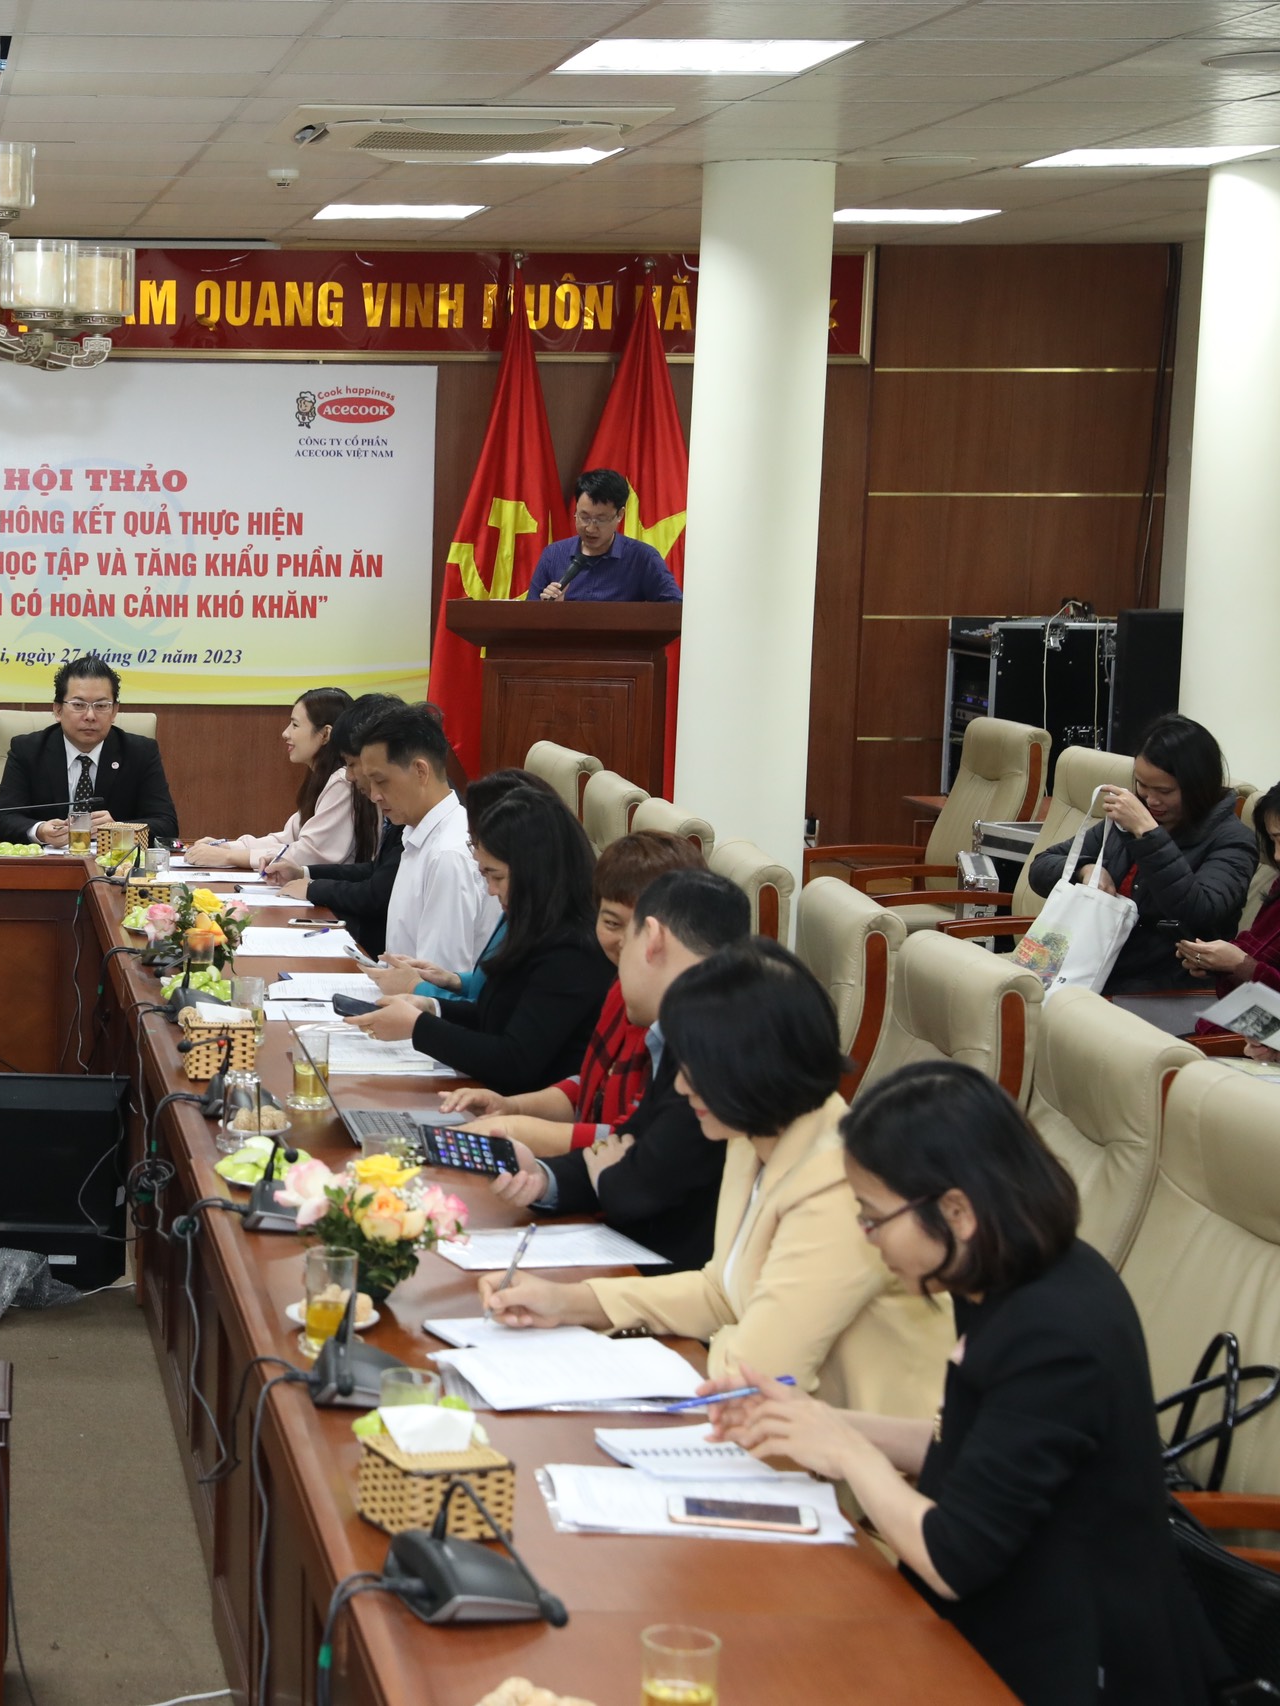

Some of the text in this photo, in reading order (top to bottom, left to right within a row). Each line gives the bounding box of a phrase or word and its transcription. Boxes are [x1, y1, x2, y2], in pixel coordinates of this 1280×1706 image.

[194, 279, 344, 331] QUANG
[361, 282, 465, 329] VINH
[317, 385, 396, 401] Cook happiness
[295, 447, 394, 459] ACECOOK VIỆT NAM
[298, 434, 388, 446] CÔNG TY CỔ PHẦN
[3, 463, 188, 497] HỘI THẢO
[72, 503, 116, 535] KẾT
[123, 503, 171, 537] QUẢ
[179, 509, 240, 541] THỰC
[247, 507, 304, 541] HIỆN
[45, 547, 89, 581] TẬP
[97, 548, 127, 576] VÀ
[134, 548, 197, 577] TĂNG
[204, 543, 269, 577] KHẨU
[276, 546, 342, 578] PHẦN
[349, 549, 384, 579] ĂN
[11, 588, 43, 617] CÓ
[49, 588, 116, 618] HOÀN
[123, 586, 189, 618] CẢNH
[196, 590, 244, 619] KHÓ
[15, 648, 56, 666] ngày
[60, 648, 81, 663] 27
[138, 649, 157, 663] 02
[162, 649, 198, 664] năm
[203, 649, 243, 664] 2023
